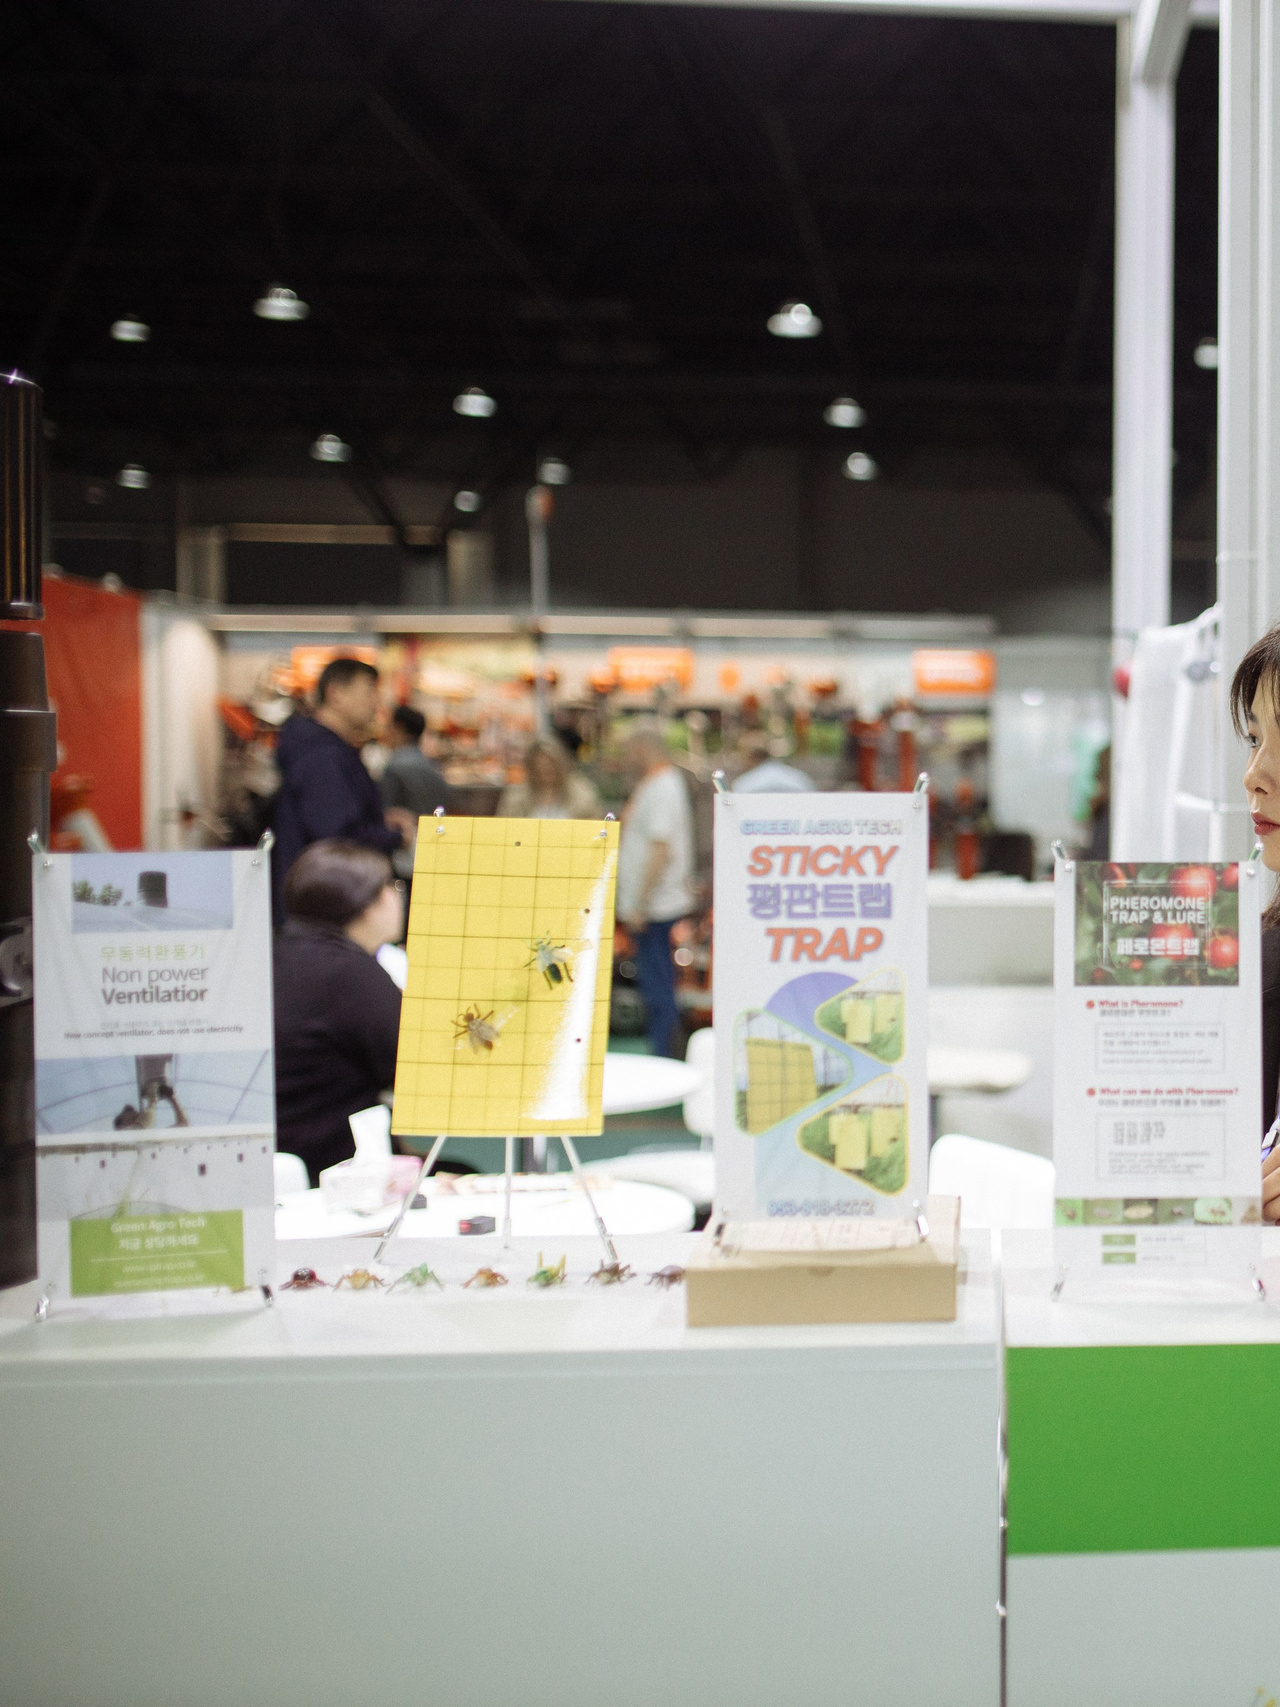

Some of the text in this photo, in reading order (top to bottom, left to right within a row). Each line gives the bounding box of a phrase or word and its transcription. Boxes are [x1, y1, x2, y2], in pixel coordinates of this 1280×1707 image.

[741, 819, 902, 835] GREEN AGRO TECH
[747, 845, 899, 877] STICKY
[747, 883, 893, 919] 평판트랩
[1109, 896, 1206, 910] PHEROMONE
[1110, 910, 1206, 924] TRAP & LURE
[765, 927, 884, 962] TRAP
[102, 966, 209, 988] Non power
[1098, 1000, 1119, 1008] What
[111, 1216, 206, 1234] Green Agro Tech
